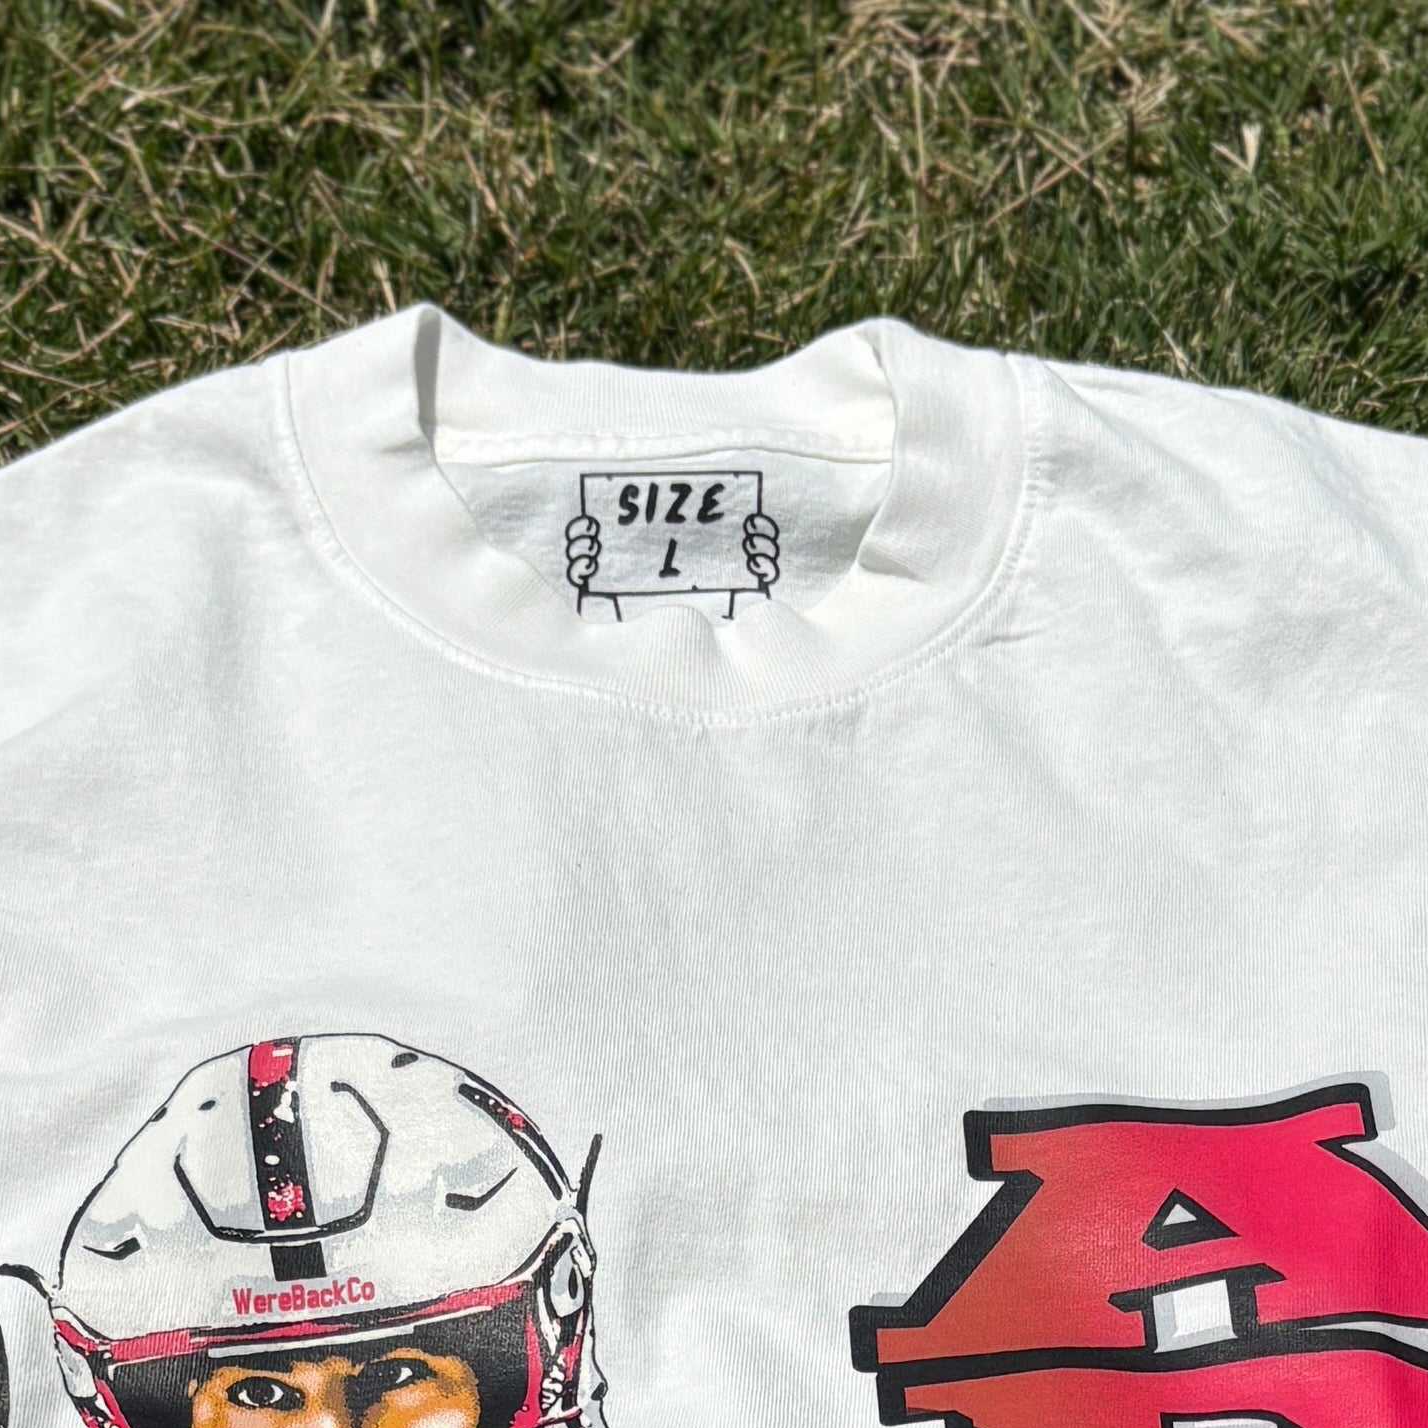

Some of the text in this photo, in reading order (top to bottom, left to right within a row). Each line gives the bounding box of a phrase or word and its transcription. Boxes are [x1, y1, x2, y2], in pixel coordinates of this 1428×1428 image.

[618, 482, 726, 525] SIZE
[659, 538, 681, 577] L
[232, 1276, 375, 1315] WereBackCo
